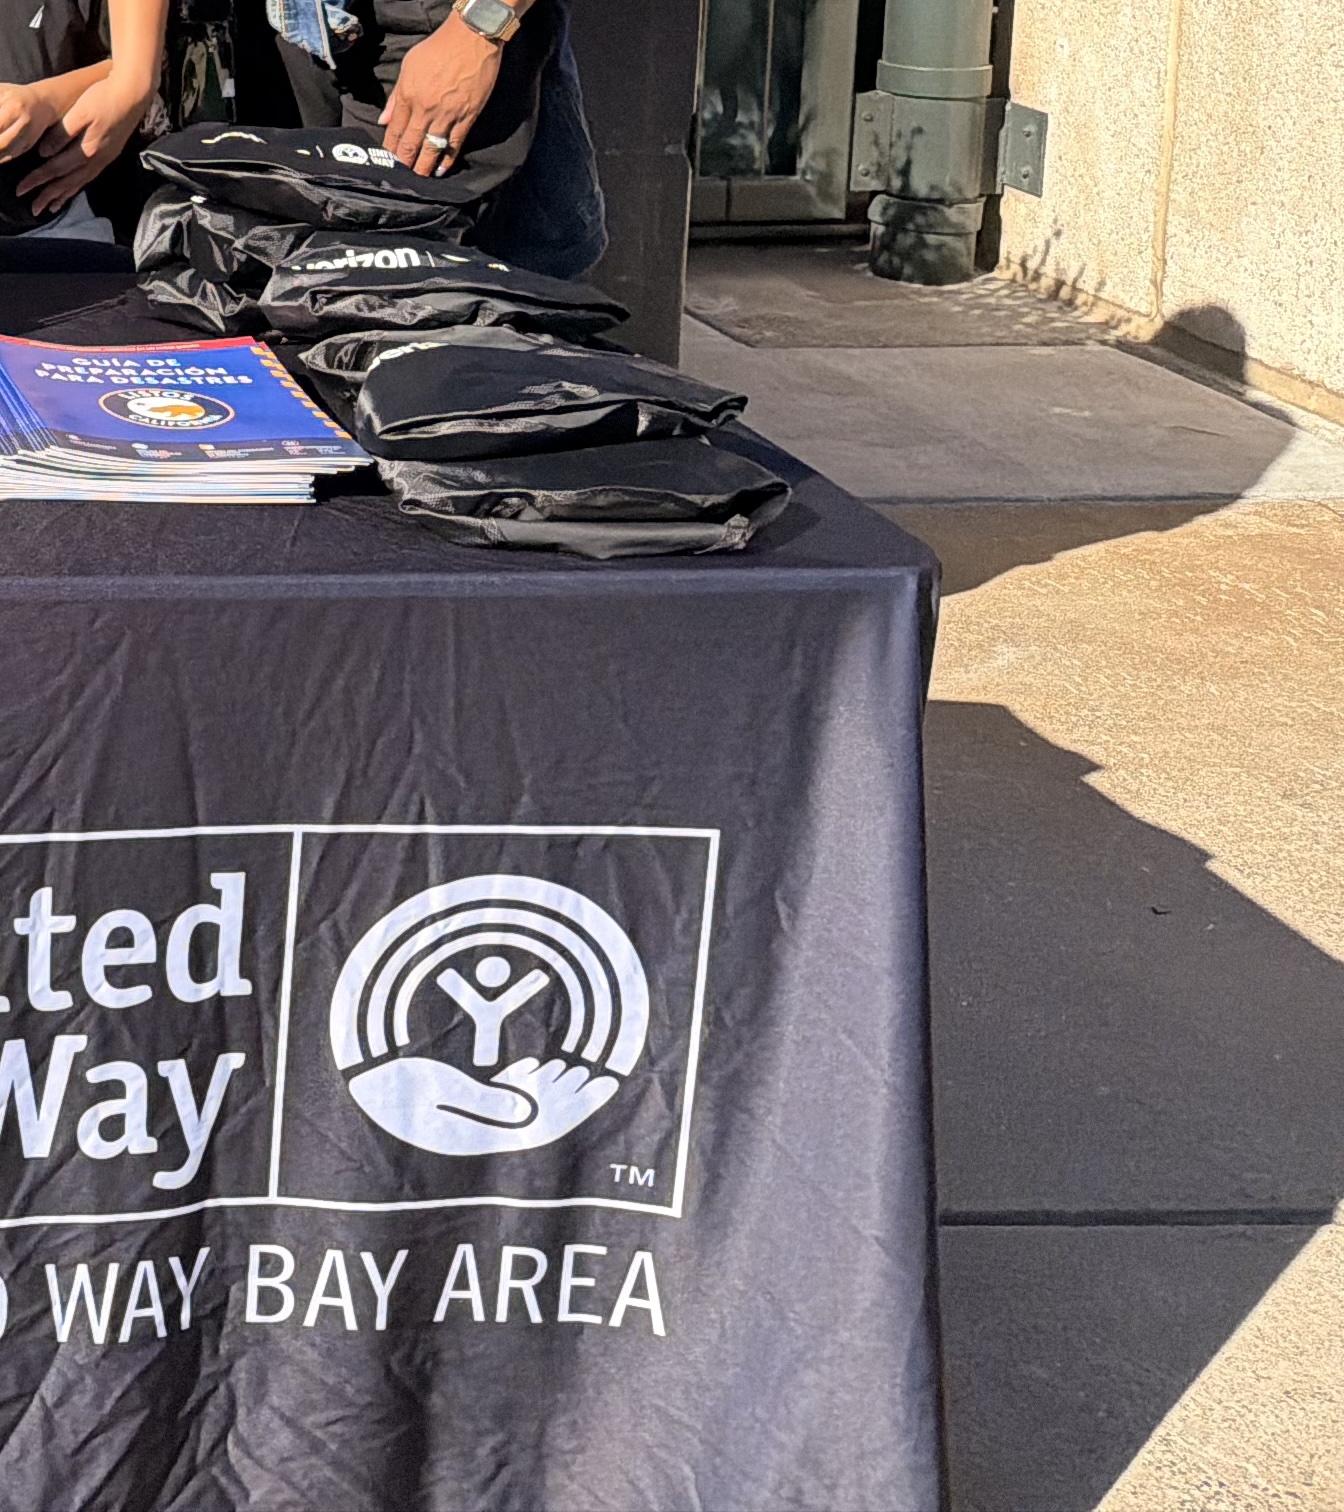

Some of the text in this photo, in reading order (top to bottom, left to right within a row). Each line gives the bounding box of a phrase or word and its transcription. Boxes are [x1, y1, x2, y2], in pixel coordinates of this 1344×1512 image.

[40, 361, 229, 377] PREPARACIÓN
[146, 358, 181, 367] DE
[34, 368, 254, 385] PARA DESASTRES
[45, 1246, 210, 1345] WAY
[244, 1242, 409, 1331] BAY
[432, 1242, 667, 1338] AREA
